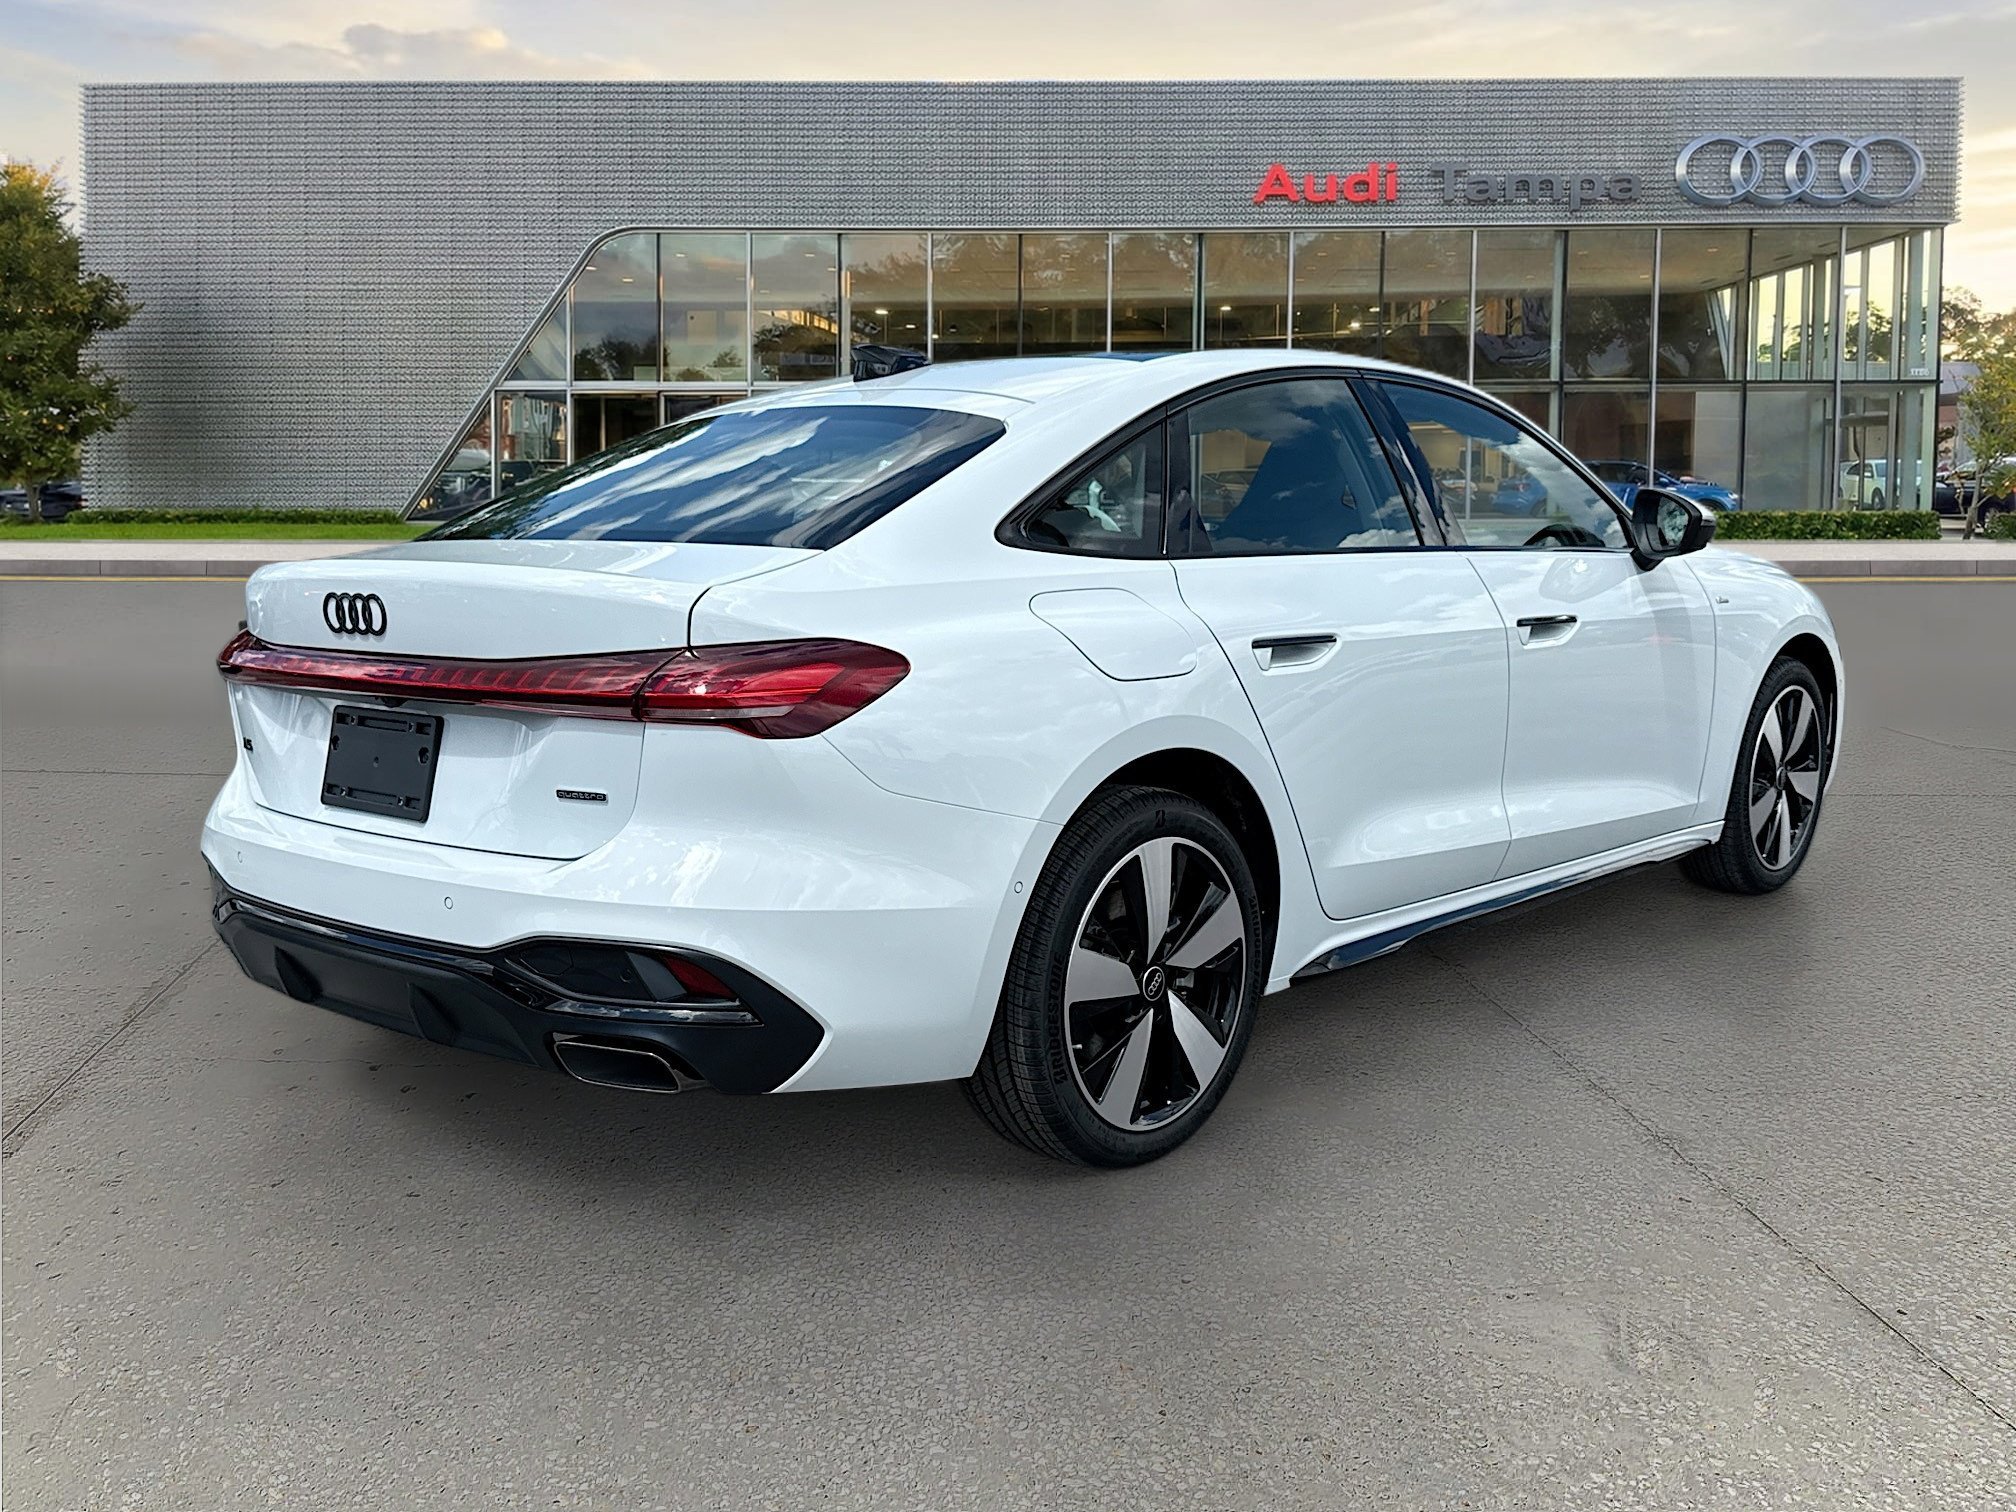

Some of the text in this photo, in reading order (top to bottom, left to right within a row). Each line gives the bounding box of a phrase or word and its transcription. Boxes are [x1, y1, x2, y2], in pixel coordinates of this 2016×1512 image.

[1253, 162, 1643, 212] Audi Tampa
[557, 791, 605, 800] quattro
[1047, 951, 1068, 1084] BRIDGESTONE
